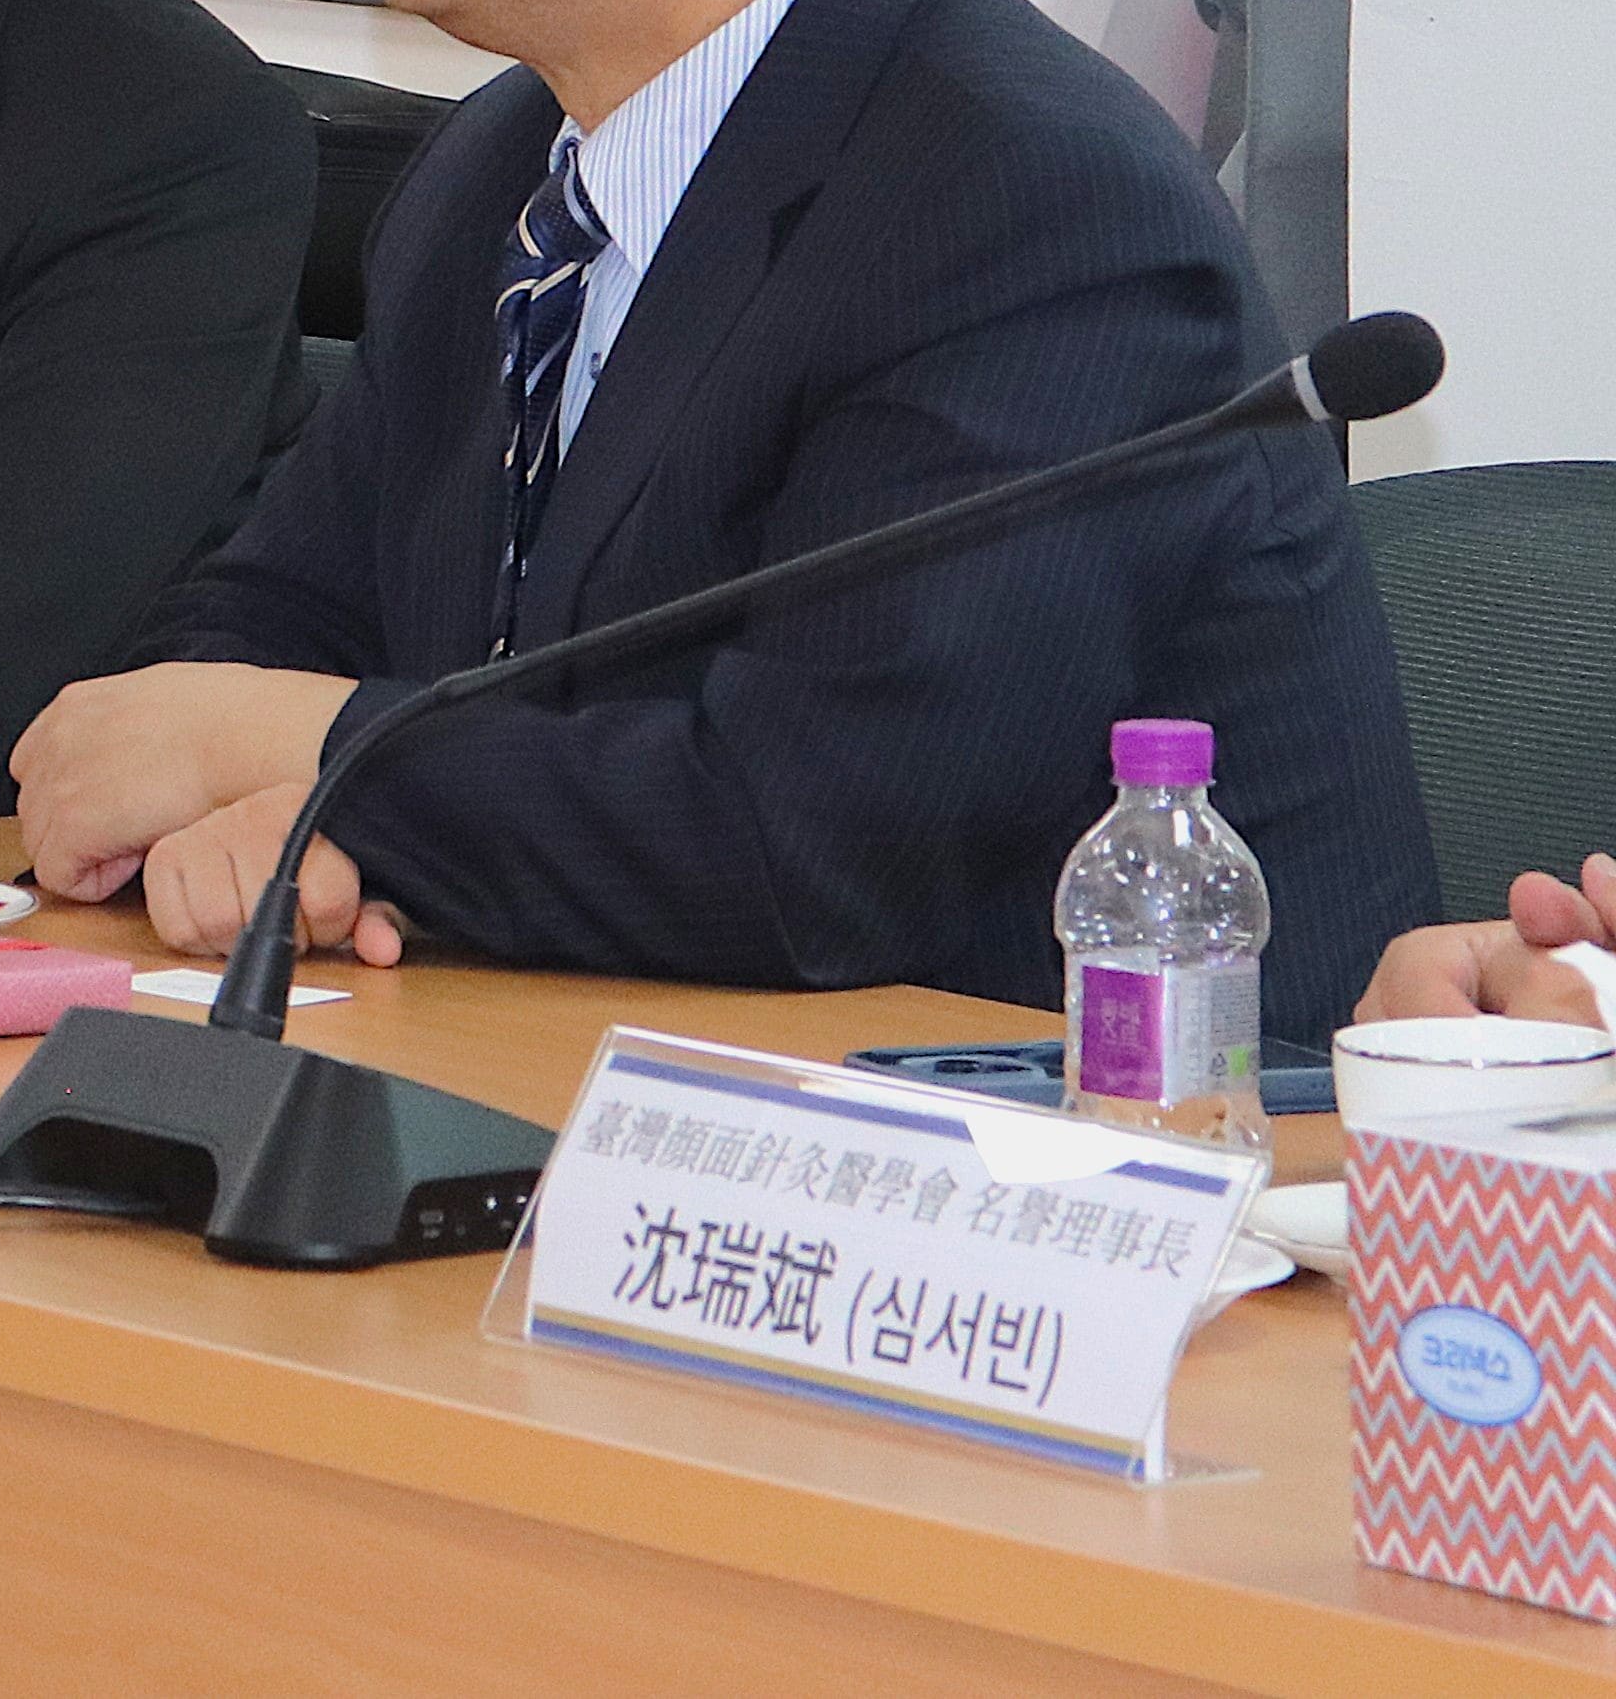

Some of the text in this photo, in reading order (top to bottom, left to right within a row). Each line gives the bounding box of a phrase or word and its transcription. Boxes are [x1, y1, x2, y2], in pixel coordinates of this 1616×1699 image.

[613, 1202, 1064, 1408] 沈瑞斌 (심서빈)
